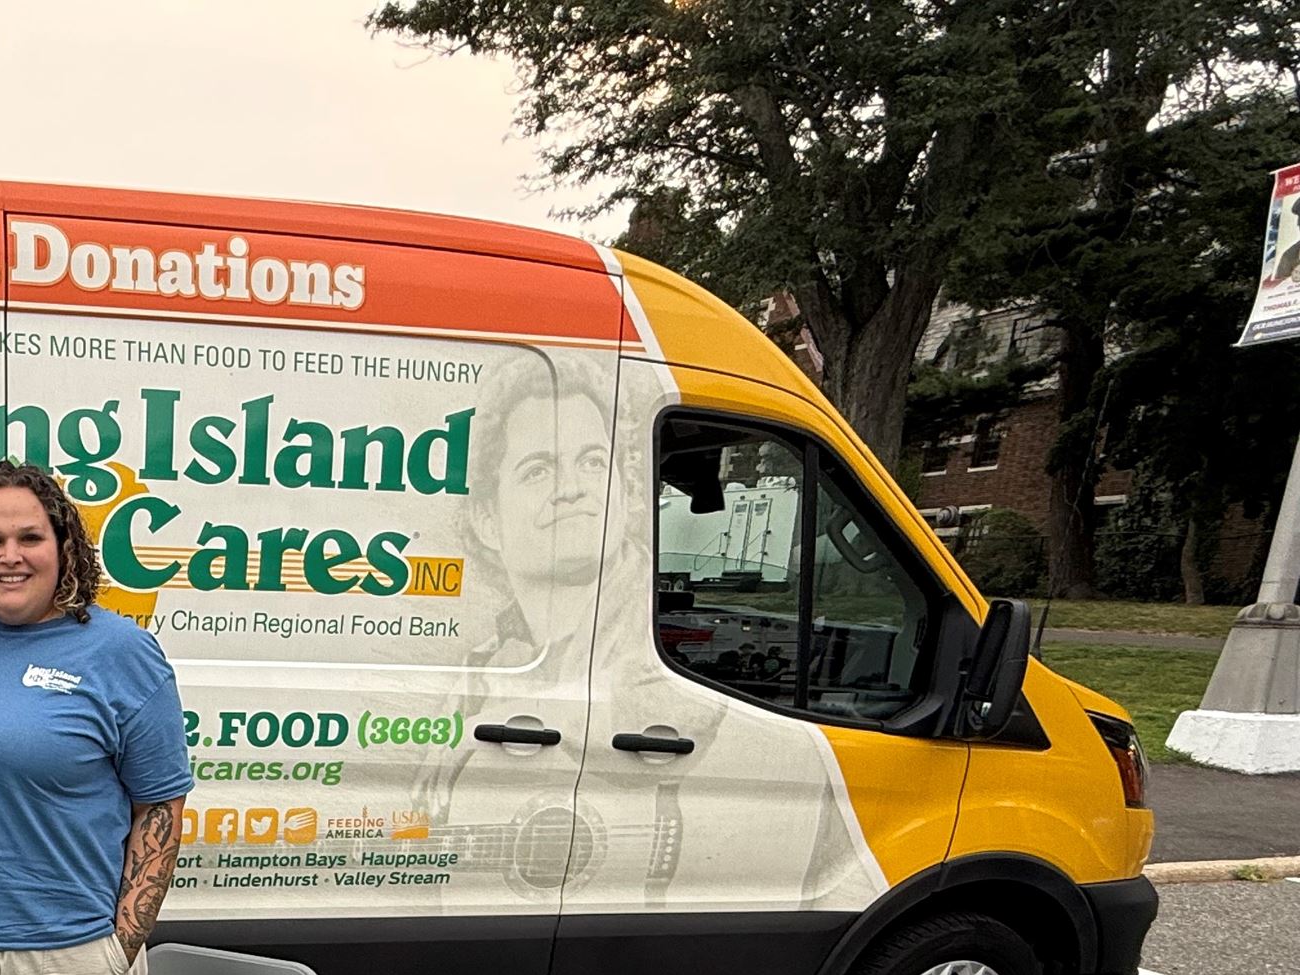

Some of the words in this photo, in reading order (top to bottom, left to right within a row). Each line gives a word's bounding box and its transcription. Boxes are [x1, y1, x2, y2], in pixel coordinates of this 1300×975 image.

[10, 219, 366, 310] Donations
[50, 335, 116, 361] MORE
[123, 340, 186, 365] THAN
[194, 344, 251, 369] FOOD
[259, 349, 286, 371] TO
[294, 352, 344, 376] FEED
[351, 355, 391, 378] THE
[397, 358, 484, 385] HUNGRY
[140, 388, 477, 495] Island
[101, 496, 411, 597] Cares
[414, 561, 461, 592] INC
[171, 609, 247, 638] Chapin
[253, 612, 344, 640] Regional
[350, 614, 402, 637] Food
[408, 617, 460, 638] Bank
[357, 709, 464, 750] (3663)
[325, 828, 384, 840] AMERICA
[327, 817, 385, 829] FEEDING
[218, 853, 302, 870] Hampton
[305, 852, 347, 868] Bays
[361, 852, 458, 869] Hauppauge
[213, 873, 318, 888] Lindenhurst
[334, 872, 386, 888] Valley
[388, 872, 451, 887] Stream
